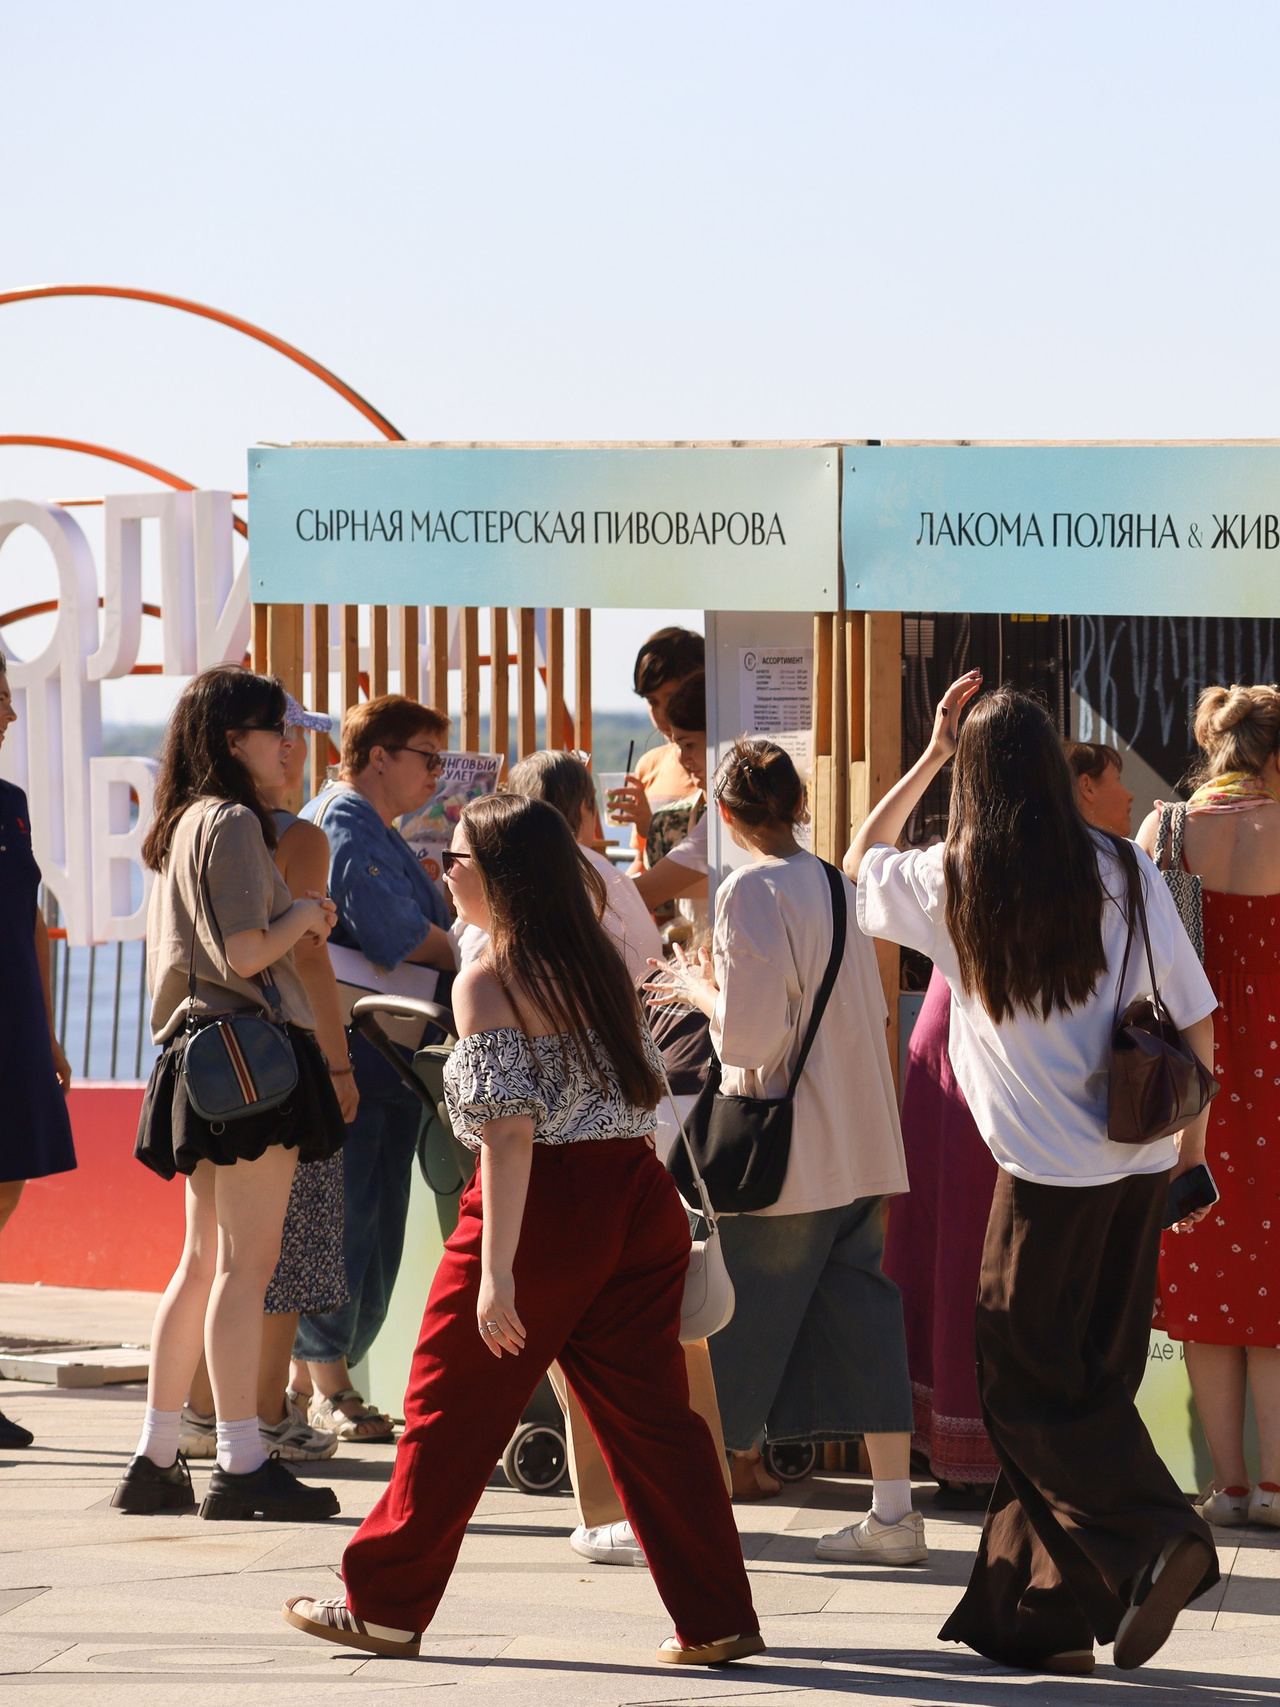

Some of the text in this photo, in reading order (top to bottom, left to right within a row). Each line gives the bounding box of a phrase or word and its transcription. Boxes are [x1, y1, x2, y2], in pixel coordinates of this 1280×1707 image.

[295, 508, 787, 546] СЫРНАЯ МАСТЕРСКАЯ ПИВОВАРОВА
[915, 511, 1045, 548] ЛАКОМА
[1052, 512, 1181, 549] ПОЛЯНА
[1187, 522, 1203, 549] &
[762, 657, 803, 665] АССОРТИМЕНТ
